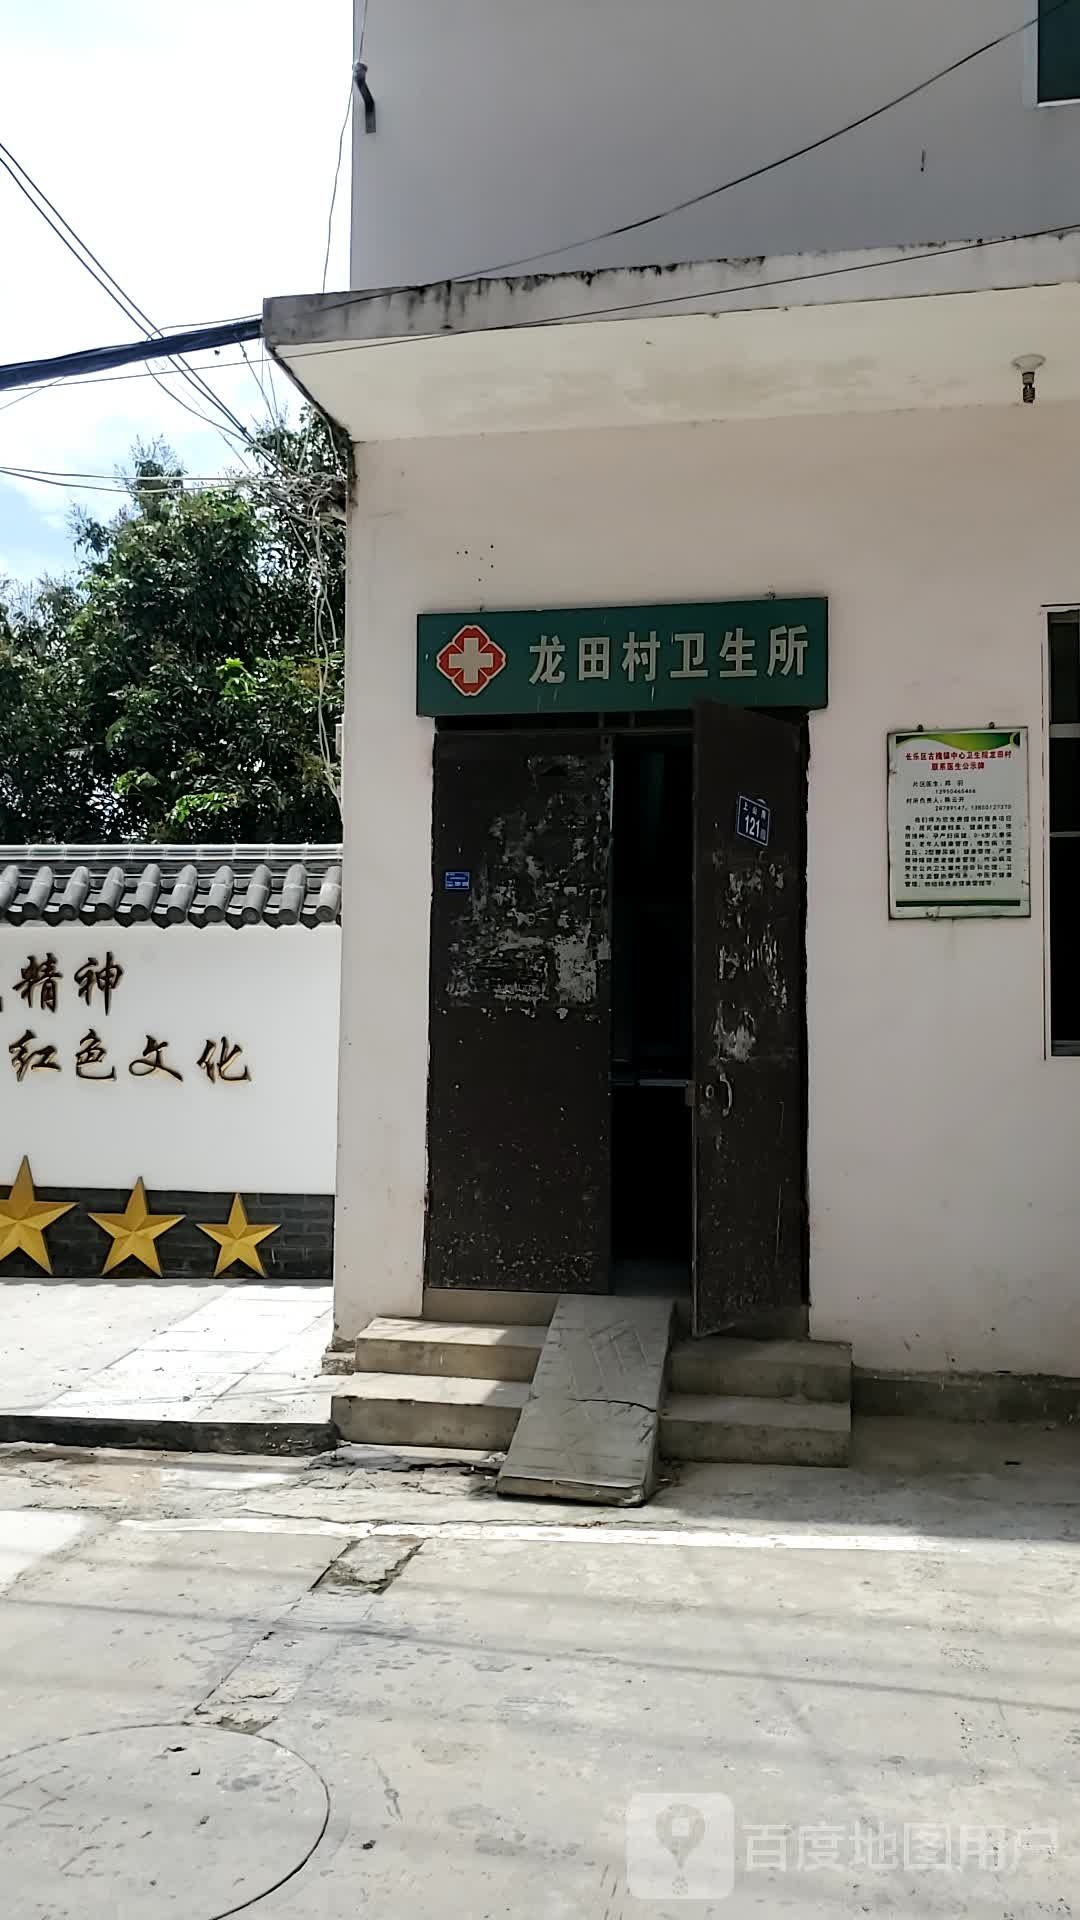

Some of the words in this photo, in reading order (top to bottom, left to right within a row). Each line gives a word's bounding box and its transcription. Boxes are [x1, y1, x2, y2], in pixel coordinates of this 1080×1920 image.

[529, 625, 809, 685] 龙田村卫生所
[745, 815, 760, 838] 121
[0, 951, 124, 1015] 精神
[8, 1029, 251, 1083] 红色文化
